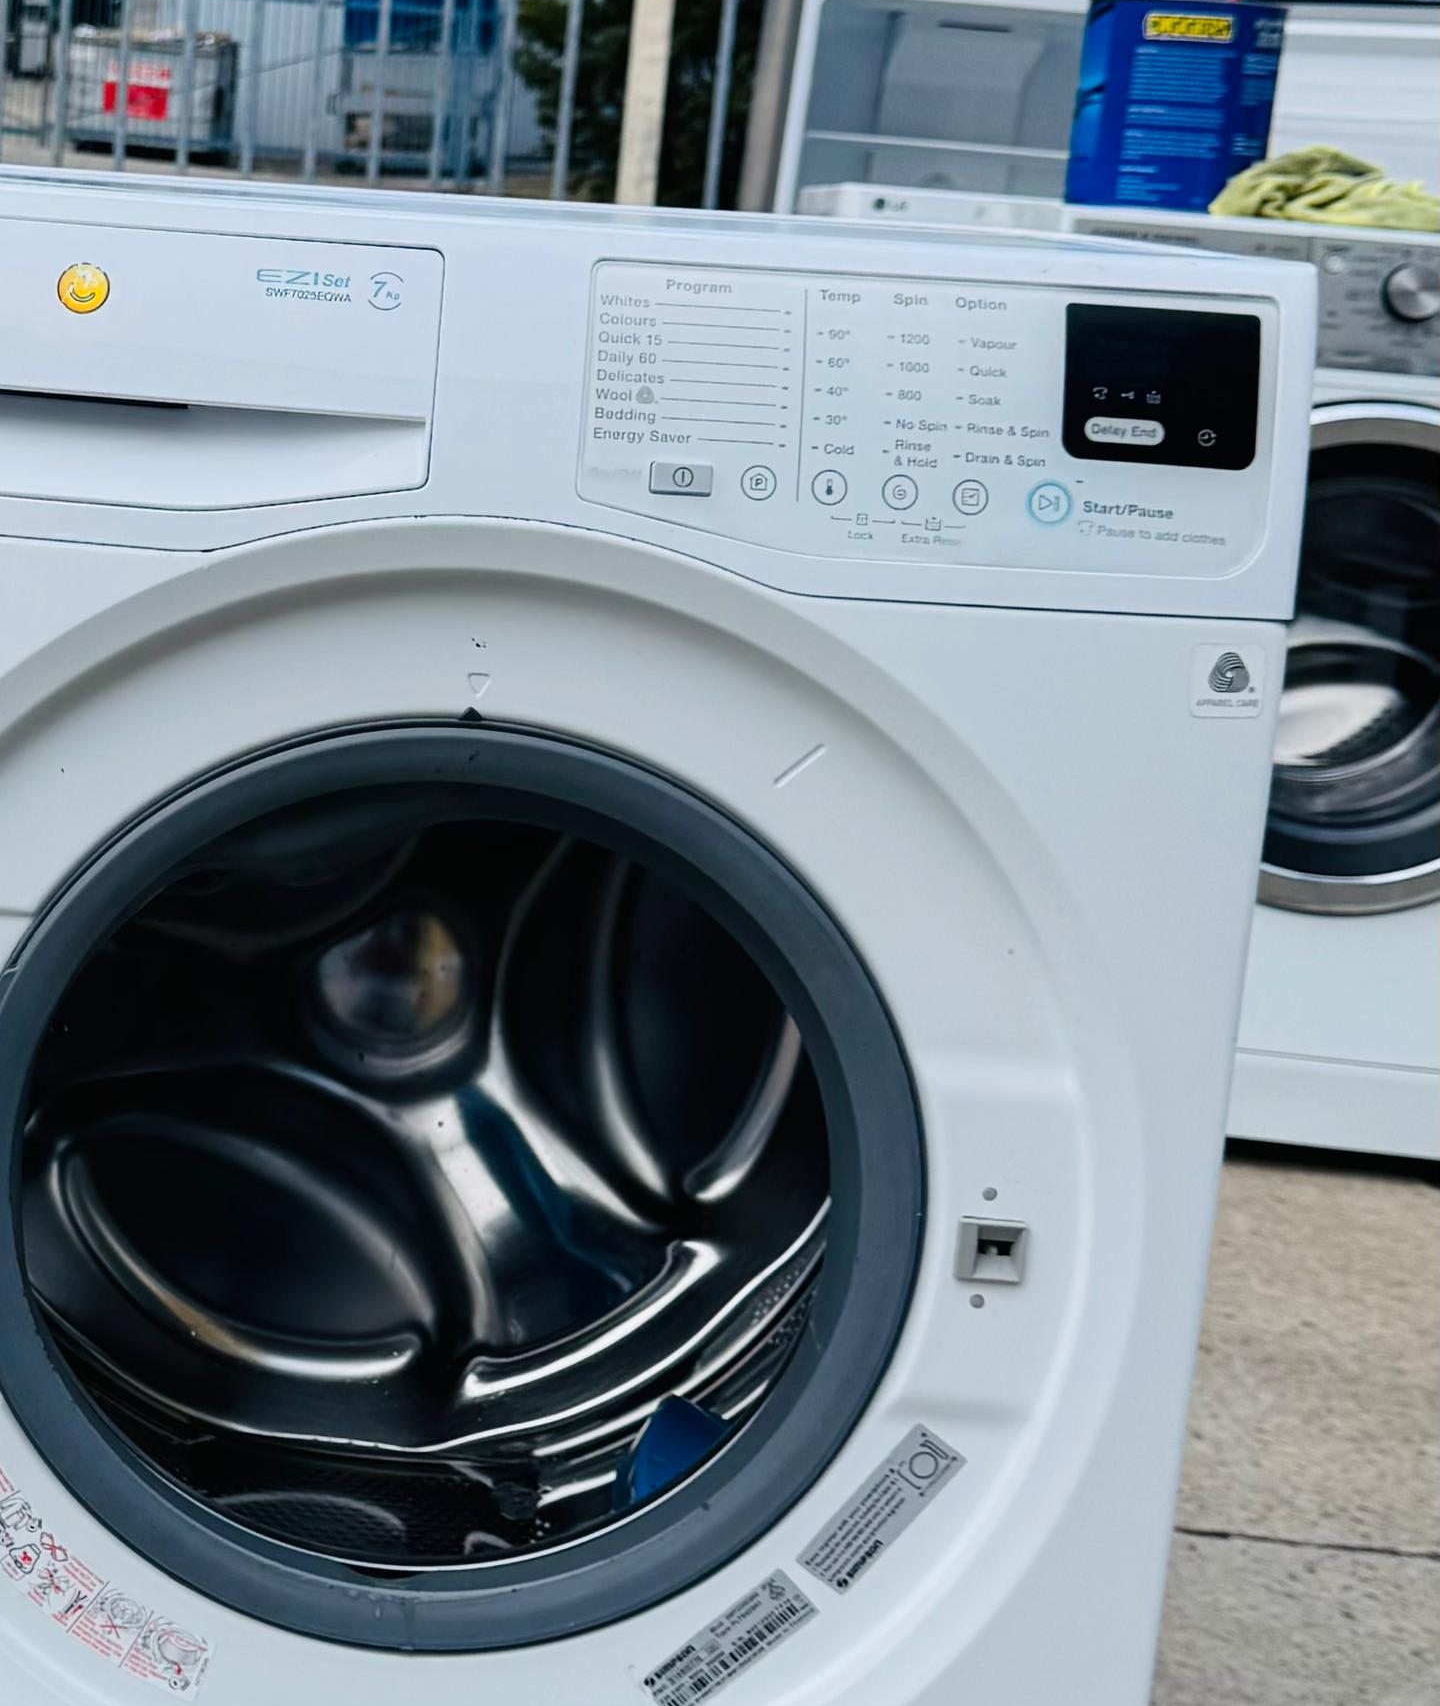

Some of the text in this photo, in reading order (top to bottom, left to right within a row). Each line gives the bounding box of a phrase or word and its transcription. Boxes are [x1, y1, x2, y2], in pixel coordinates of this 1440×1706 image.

[322, 273, 352, 288] Set
[666, 278, 733, 295] Program
[373, 281, 387, 298] 7
[820, 289, 862, 304] Temp
[600, 294, 651, 308] Whites
[893, 293, 928, 308] Spin
[955, 296, 1008, 311] Option
[599, 312, 658, 327] Colours
[598, 331, 663, 346] Quick 15
[900, 334, 931, 346] 1200
[970, 337, 1018, 351] Vapour
[597, 349, 657, 367] Daily 60
[898, 362, 930, 374] 1000
[969, 365, 1008, 379] Quick
[596, 368, 665, 385] Delicates
[595, 388, 633, 402] Wool
[897, 389, 922, 402] 800
[967, 394, 1001, 407] Soak
[594, 406, 657, 425] Bedding
[896, 418, 948, 432] No Spin
[967, 422, 1050, 439] Rinse & Spin
[1091, 423, 1157, 439] Delay End
[593, 426, 693, 444] Energy Saver
[823, 443, 855, 456] Cold
[895, 439, 932, 452] Rinse
[894, 455, 938, 469] & Hold
[965, 451, 1047, 468] Drain & Spin
[1082, 500, 1174, 520] Start/Pause
[847, 530, 873, 541] Lock
[901, 533, 930, 545] Extra
[1097, 525, 1227, 546] Pause to add clothes
[654, 1645, 696, 1680] SIMPSON
